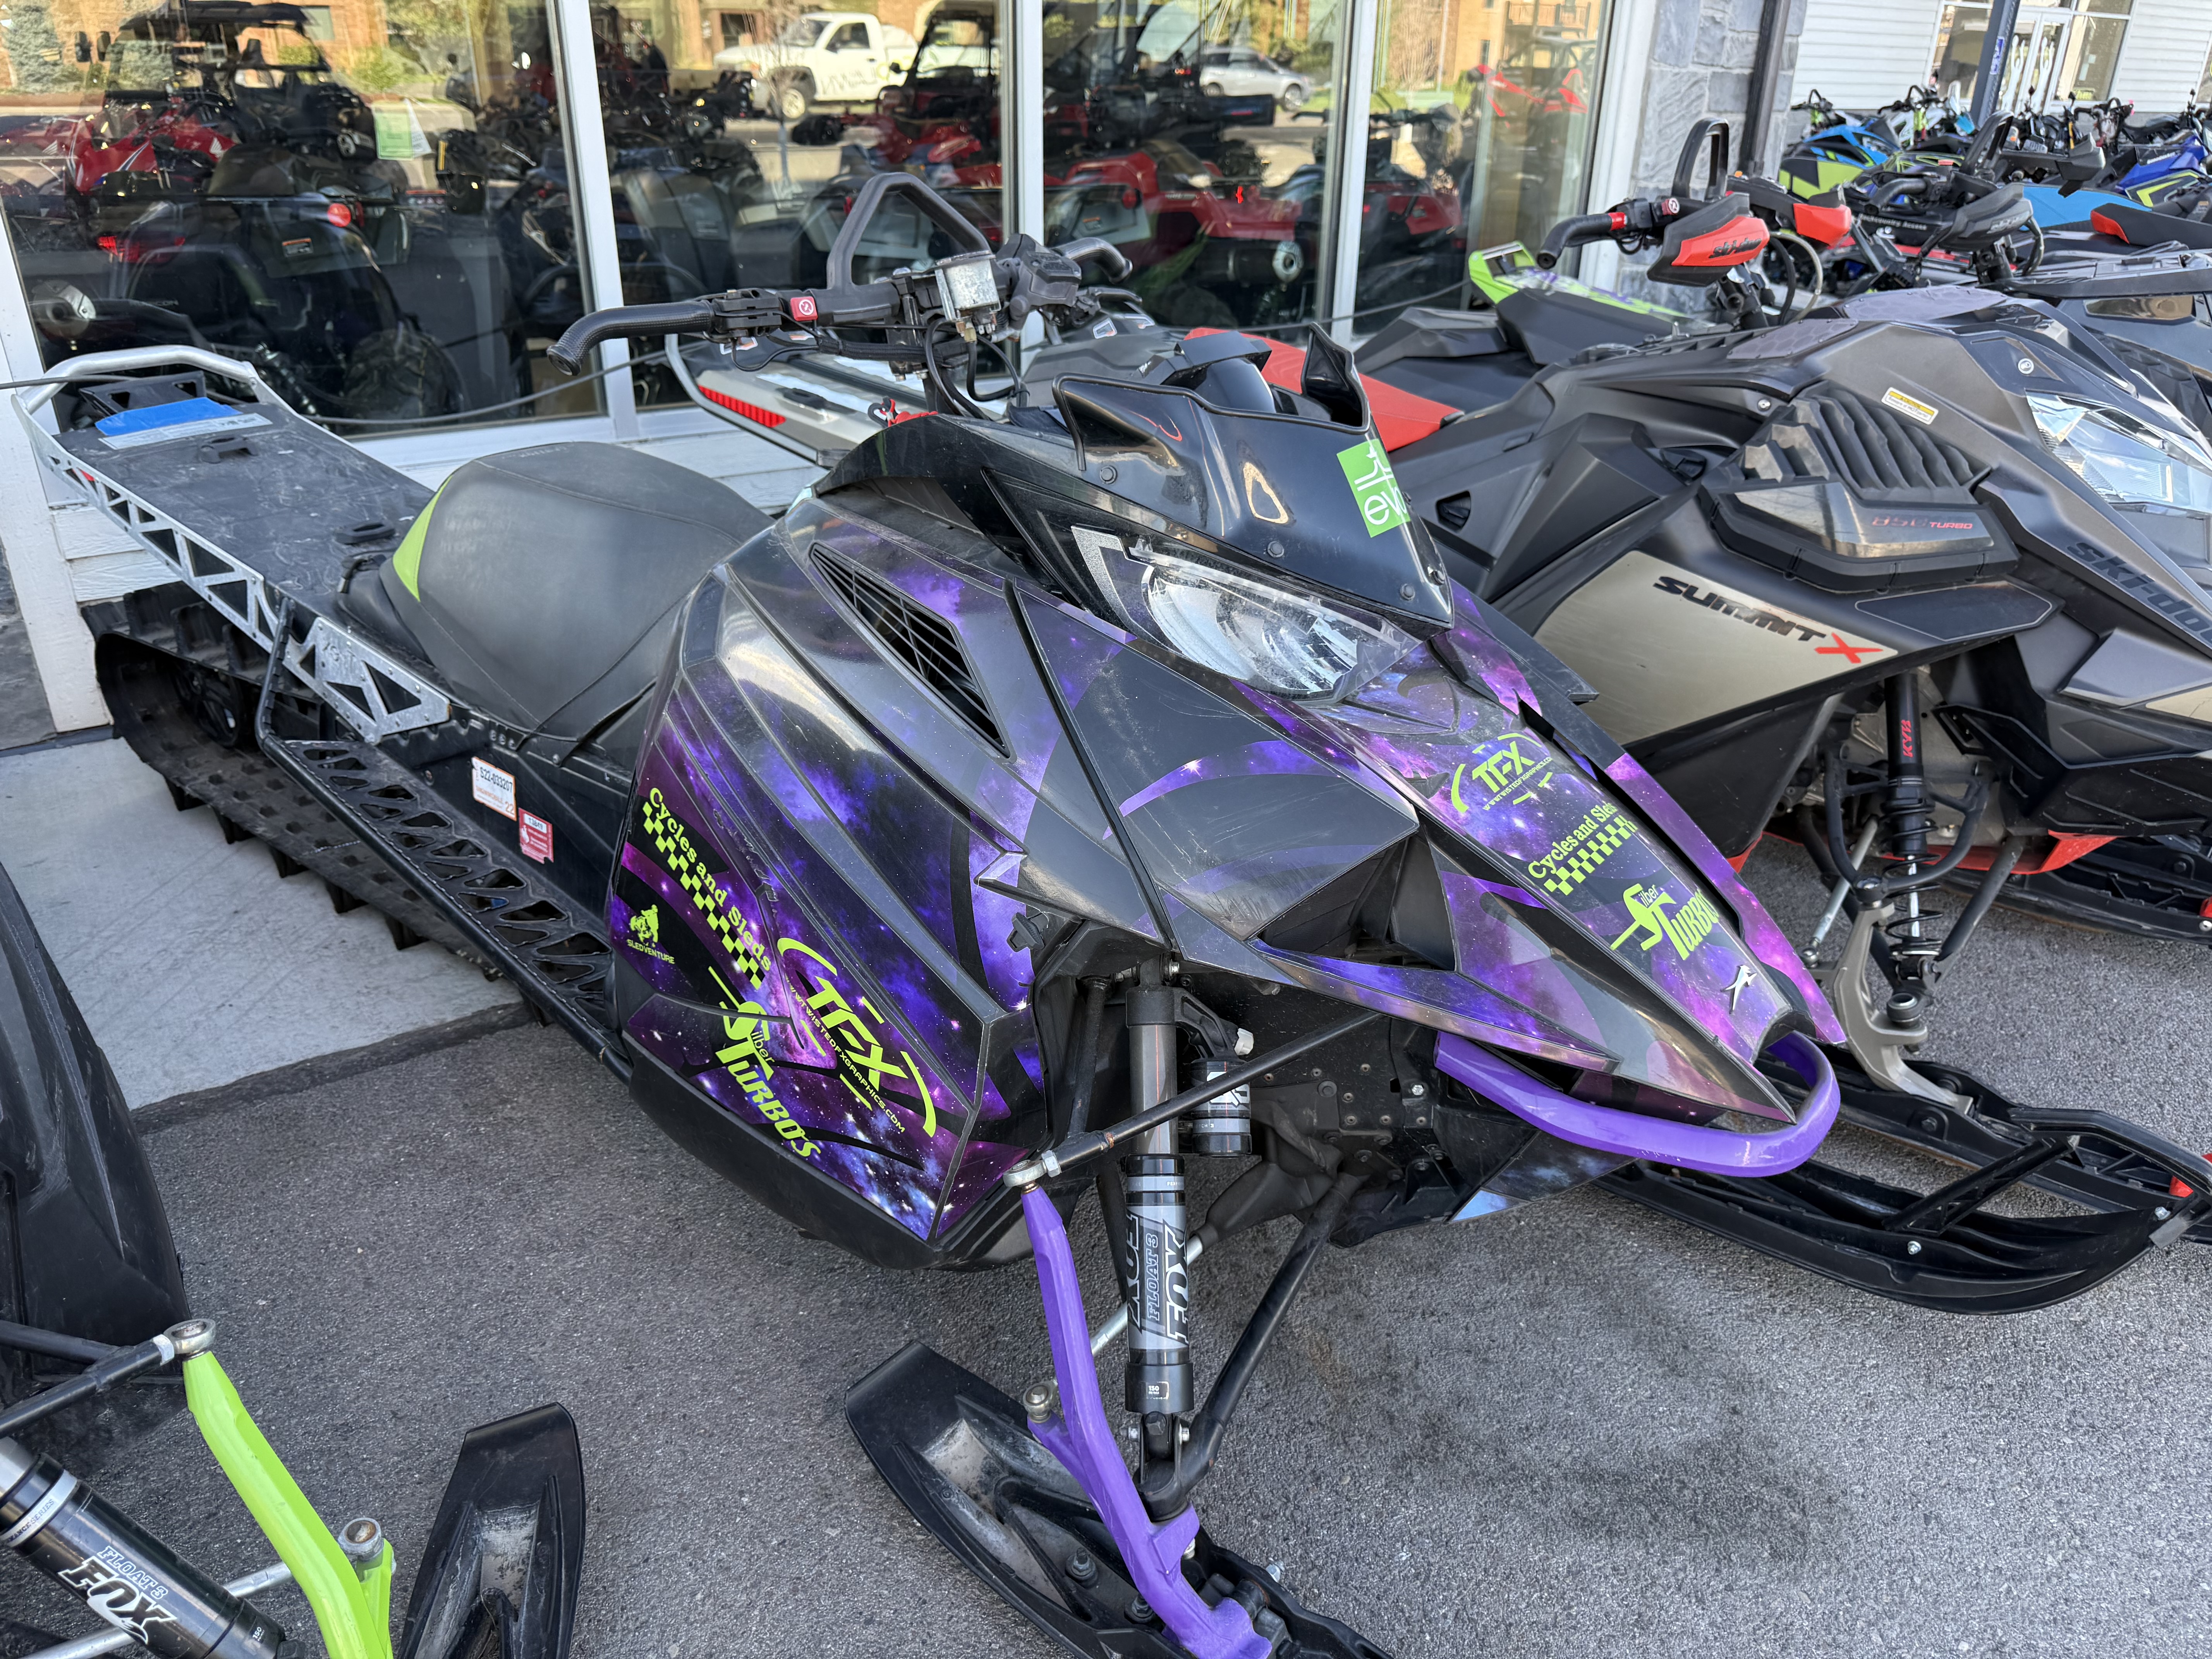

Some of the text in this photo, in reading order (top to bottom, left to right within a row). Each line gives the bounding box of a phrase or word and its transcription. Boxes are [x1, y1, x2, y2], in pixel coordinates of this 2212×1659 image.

[1652, 576, 1883, 664] SUMMIT X
[1472, 741, 1535, 793] TFX
[1901, 720, 1913, 757] KYB
[1528, 835, 1579, 878] Cycles
[1573, 814, 1599, 841] and
[649, 787, 772, 971] Cycles and Sleds
[627, 939, 675, 965] SLEDVENTURE
[807, 975, 908, 1091] TFX
[1146, 1233, 1160, 1321] FLOAT 3
[1164, 1223, 1189, 1345] FOX
[31, 1499, 54, 1524] SERIES
[57, 1556, 177, 1645] FOX
[97, 1546, 169, 1600] FLOAT 3
[252, 1626, 262, 1639] 150
